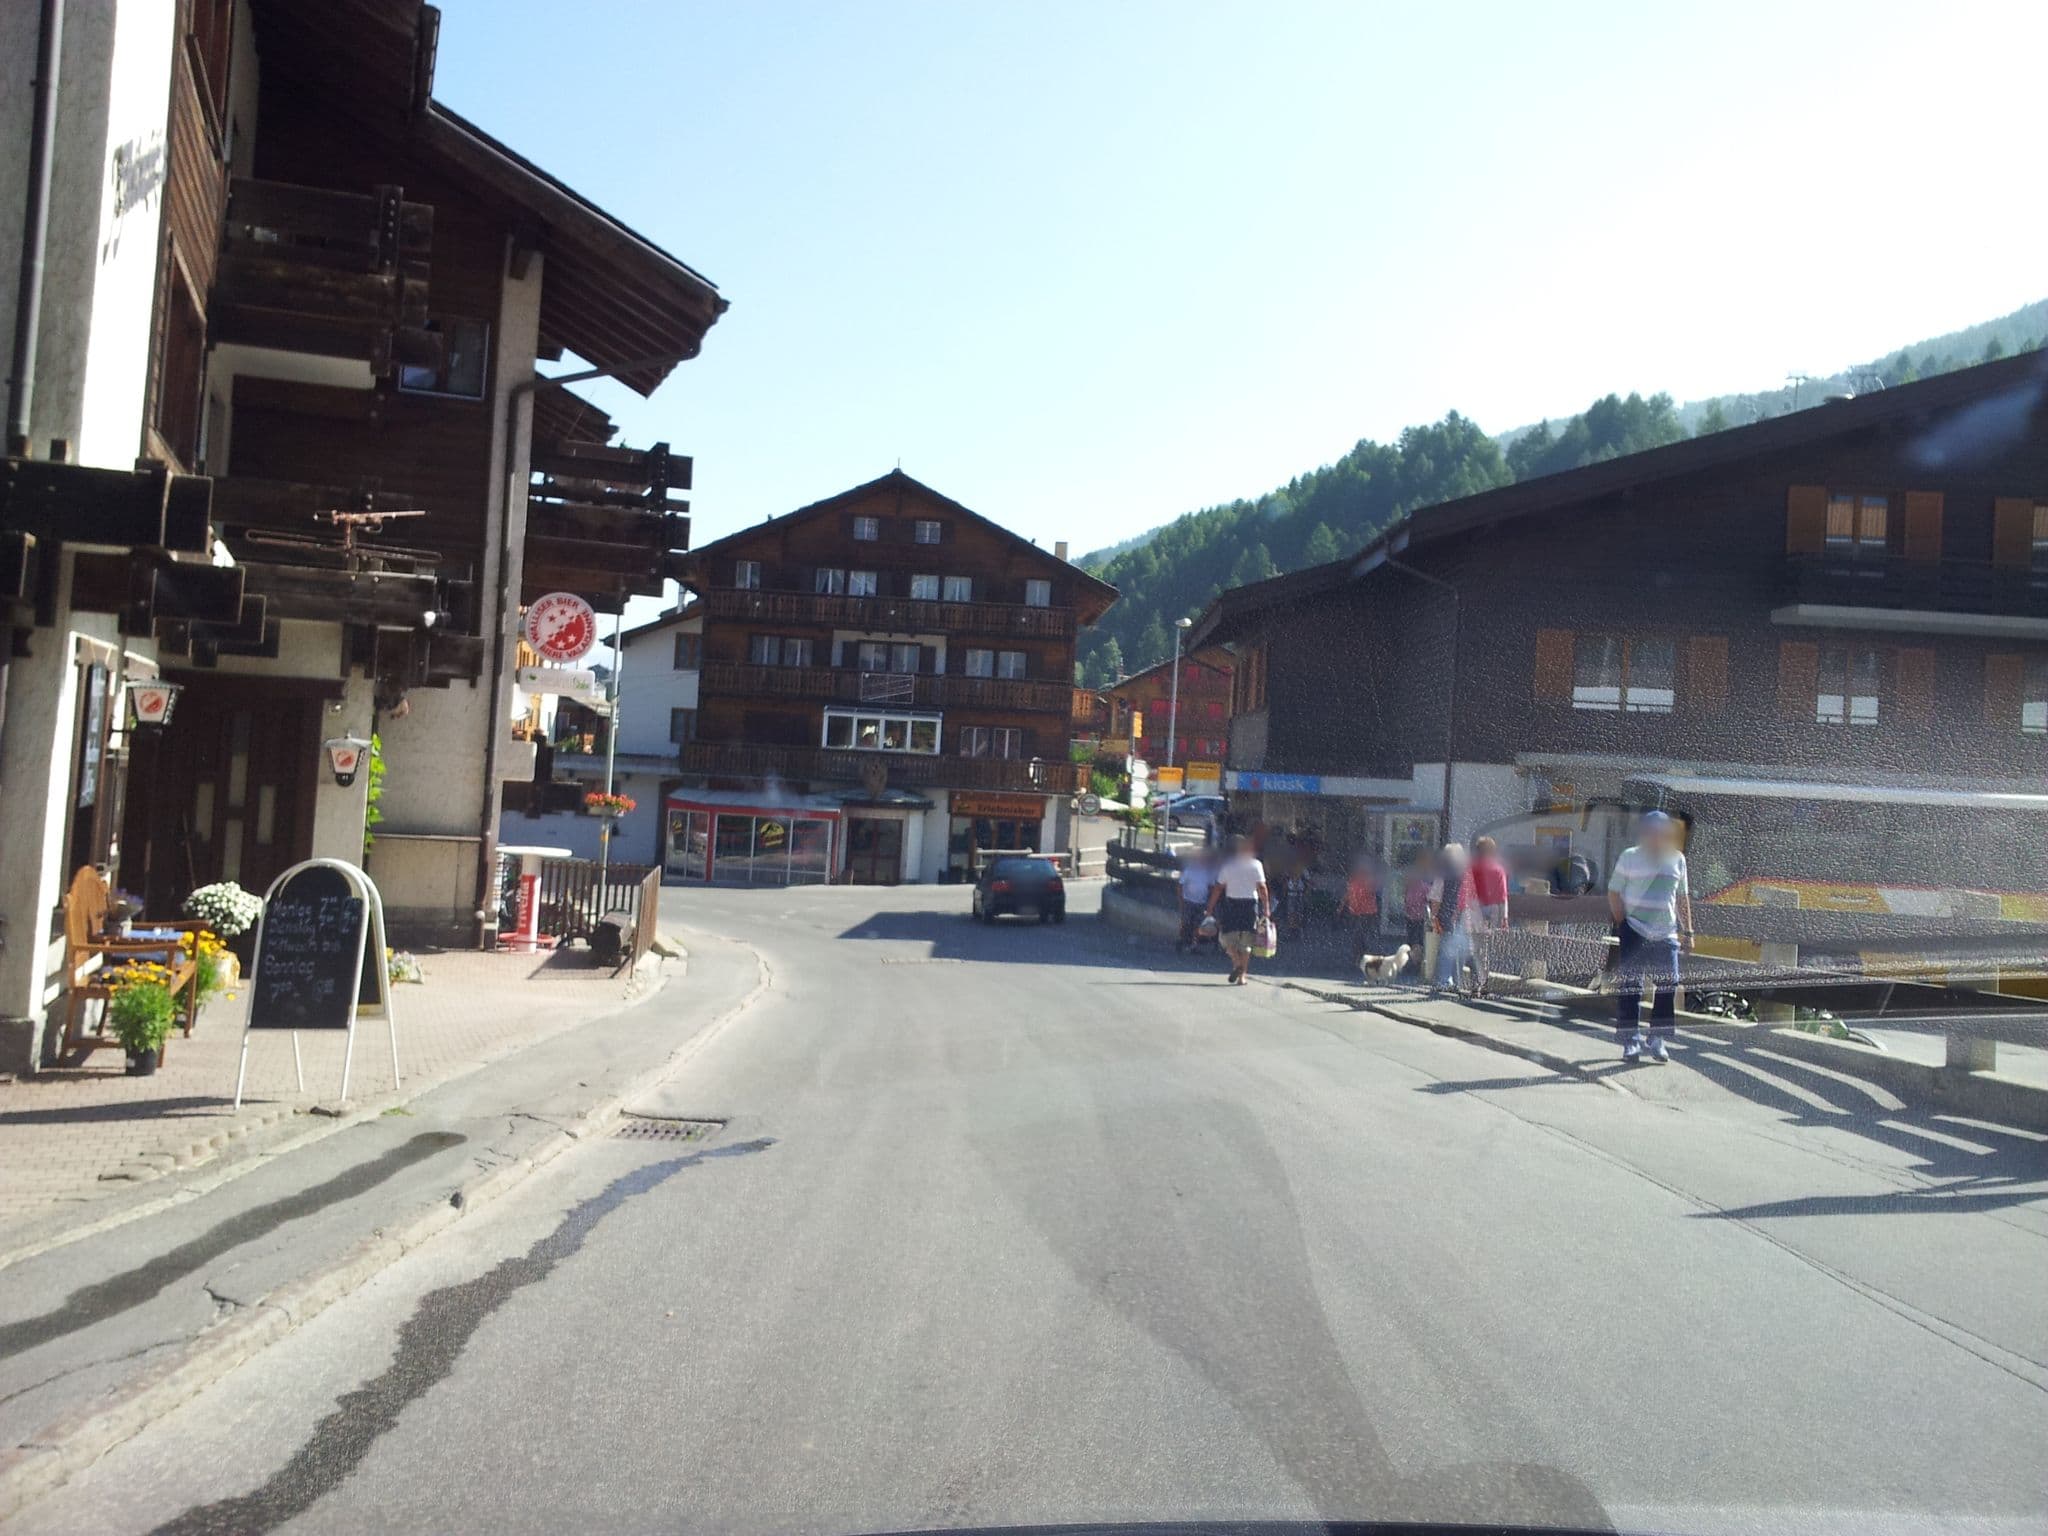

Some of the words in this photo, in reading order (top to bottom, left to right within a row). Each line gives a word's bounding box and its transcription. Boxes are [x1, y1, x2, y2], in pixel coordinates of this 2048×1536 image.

[530, 600, 553, 643] WALLISER
[556, 597, 579, 610] BIER
[1264, 776, 1306, 792] kiosk
